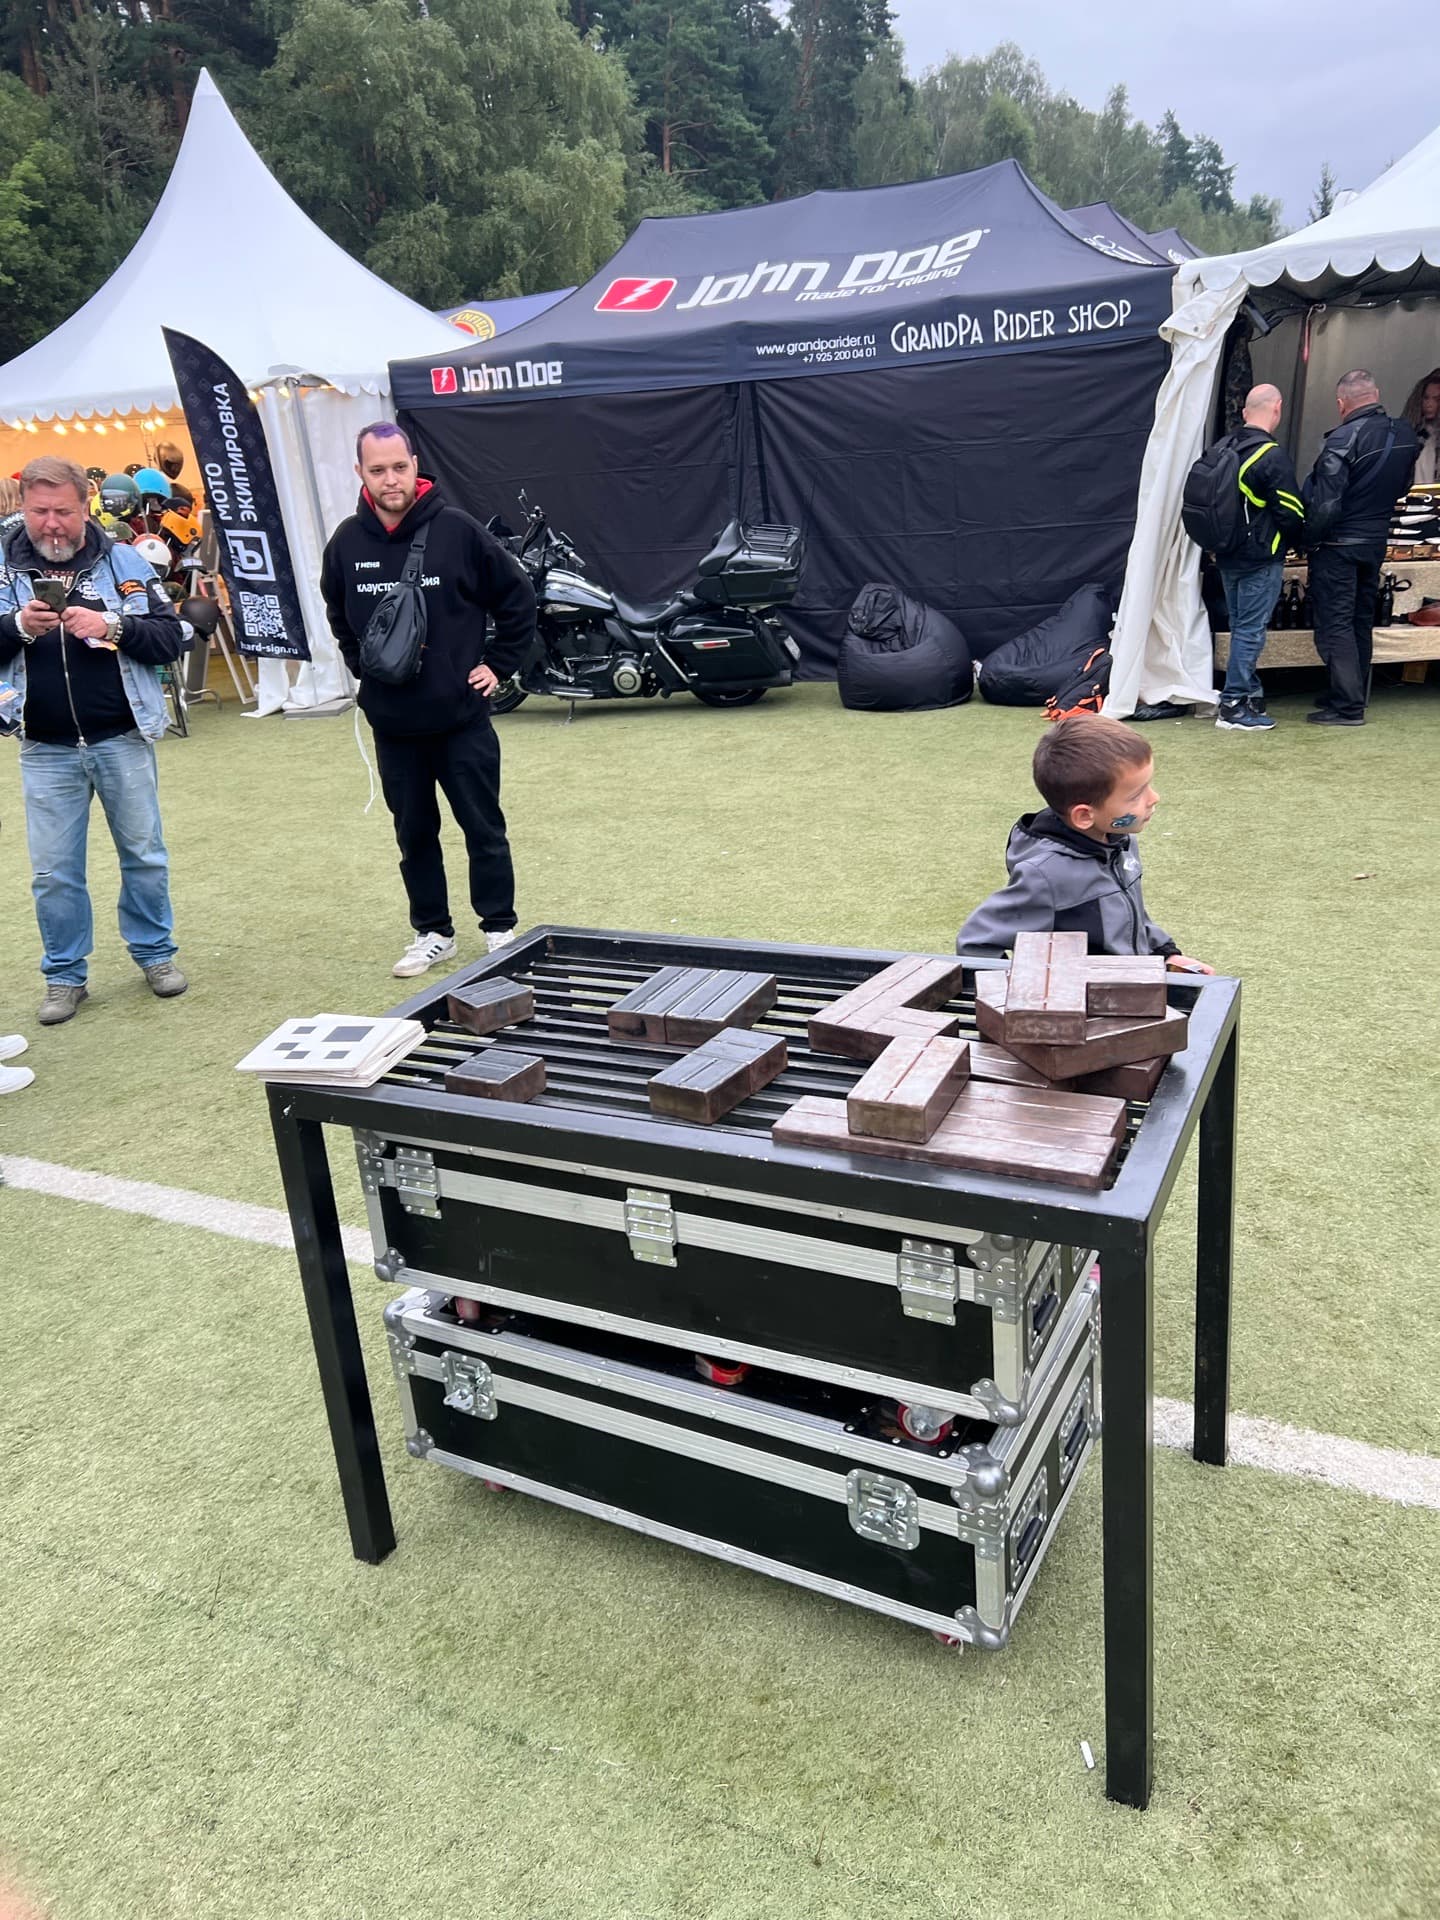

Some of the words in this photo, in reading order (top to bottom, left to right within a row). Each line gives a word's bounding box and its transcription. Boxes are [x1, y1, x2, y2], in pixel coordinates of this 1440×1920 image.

[676, 261, 830, 310] John
[837, 230, 984, 288] Doe
[794, 288, 857, 302] made
[803, 353, 814, 364] +7
[815, 352, 833, 363] 925
[834, 350, 851, 361] 200
[852, 349, 864, 360] 04
[865, 347, 877, 358] 01
[461, 363, 513, 392] John
[515, 360, 563, 388] Doe
[212, 382, 258, 523] ЭКИПИРОВКА
[204, 462, 233, 522] МОТО
[356, 574, 440, 595] клаустрбия
[240, 641, 299, 655] hard-sign.ru
